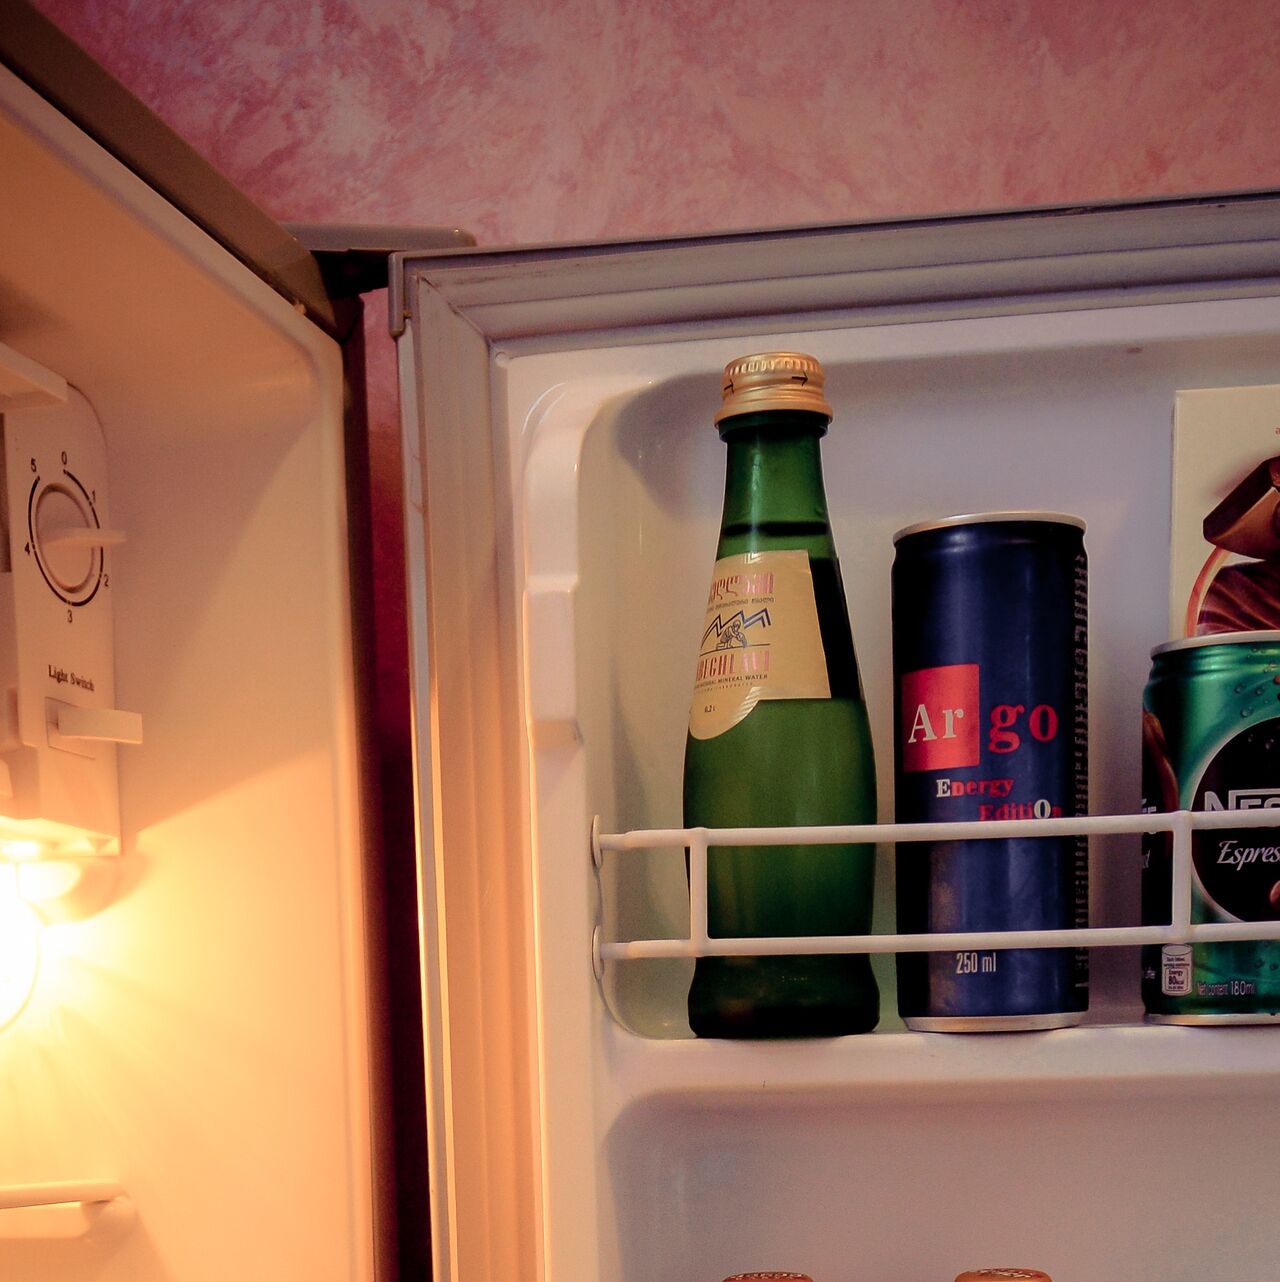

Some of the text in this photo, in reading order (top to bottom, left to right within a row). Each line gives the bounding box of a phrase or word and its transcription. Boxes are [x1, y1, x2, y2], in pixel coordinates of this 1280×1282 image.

[30, 457, 38, 473] 5
[24, 541, 31, 555] 4
[103, 574, 109, 587] 2
[67, 609, 74, 623] 3
[48, 664, 95, 692] Light Switch
[745, 673, 768, 681] WATER
[936, 779, 1016, 799] Energy
[956, 951, 997, 975] 250 ml
[1230, 980, 1256, 997] 180ml
